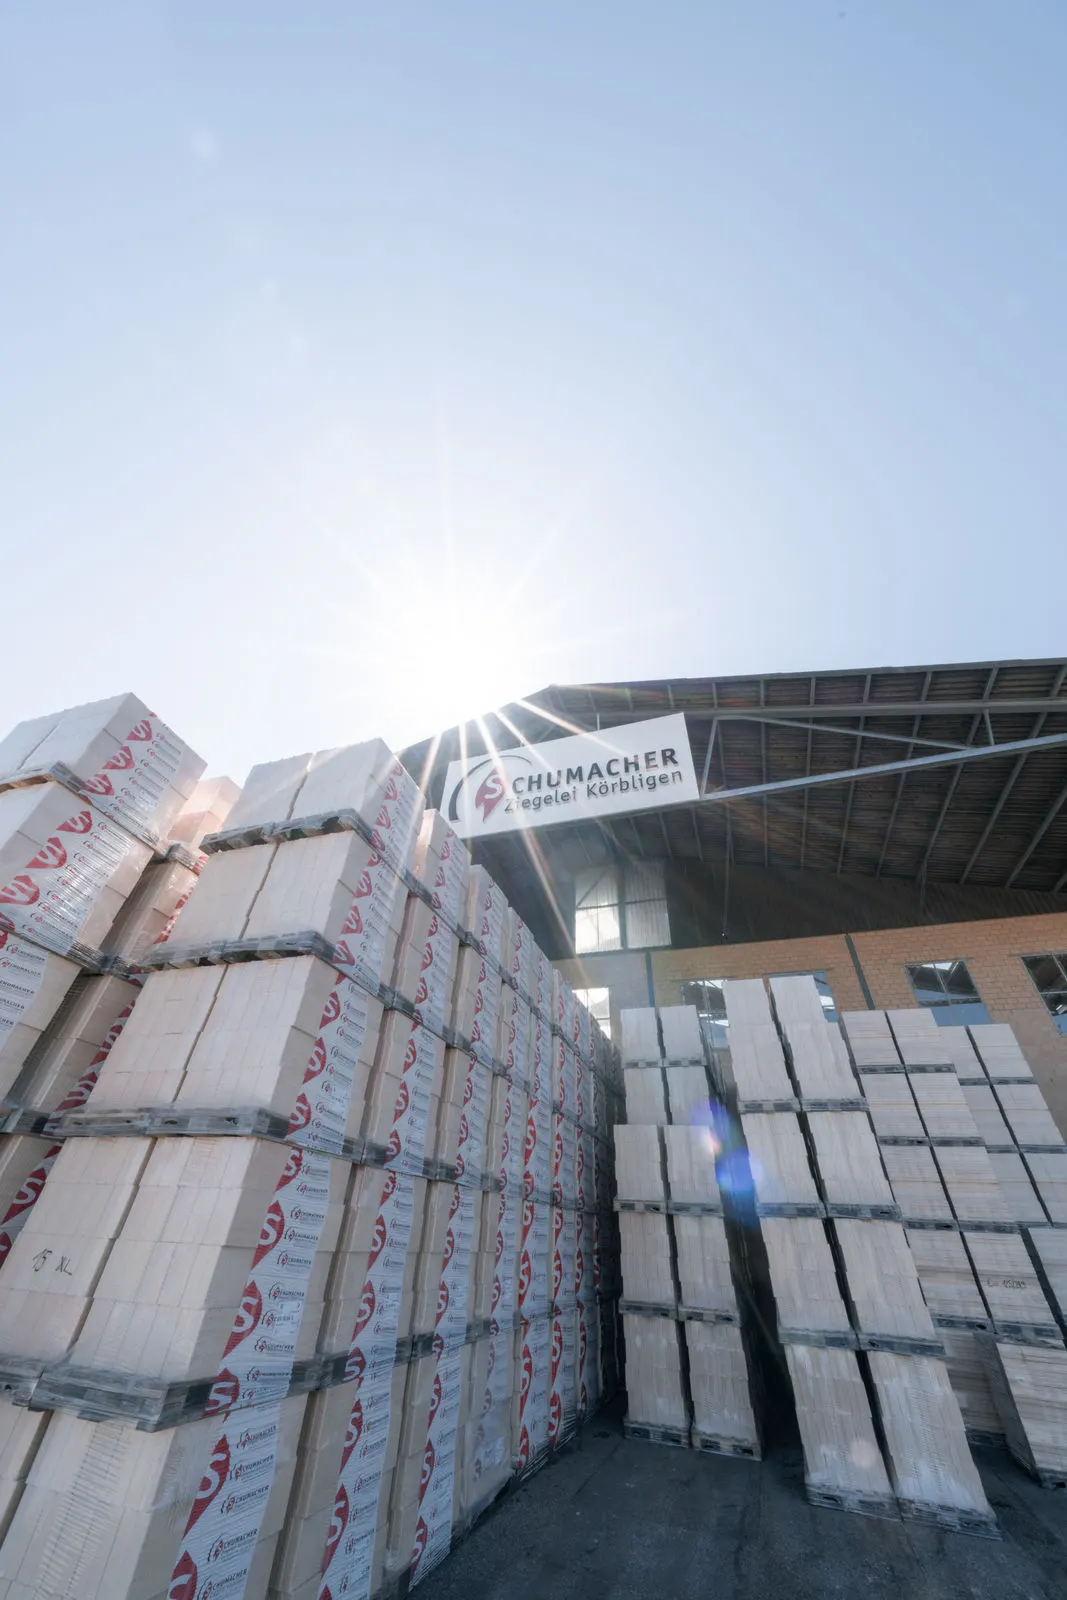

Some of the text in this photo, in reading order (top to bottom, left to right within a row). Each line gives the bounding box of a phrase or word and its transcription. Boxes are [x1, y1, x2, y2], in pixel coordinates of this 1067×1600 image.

[484, 748, 678, 799] SCHUMACHER
[504, 770, 682, 812] Ziegelei Körbligen
